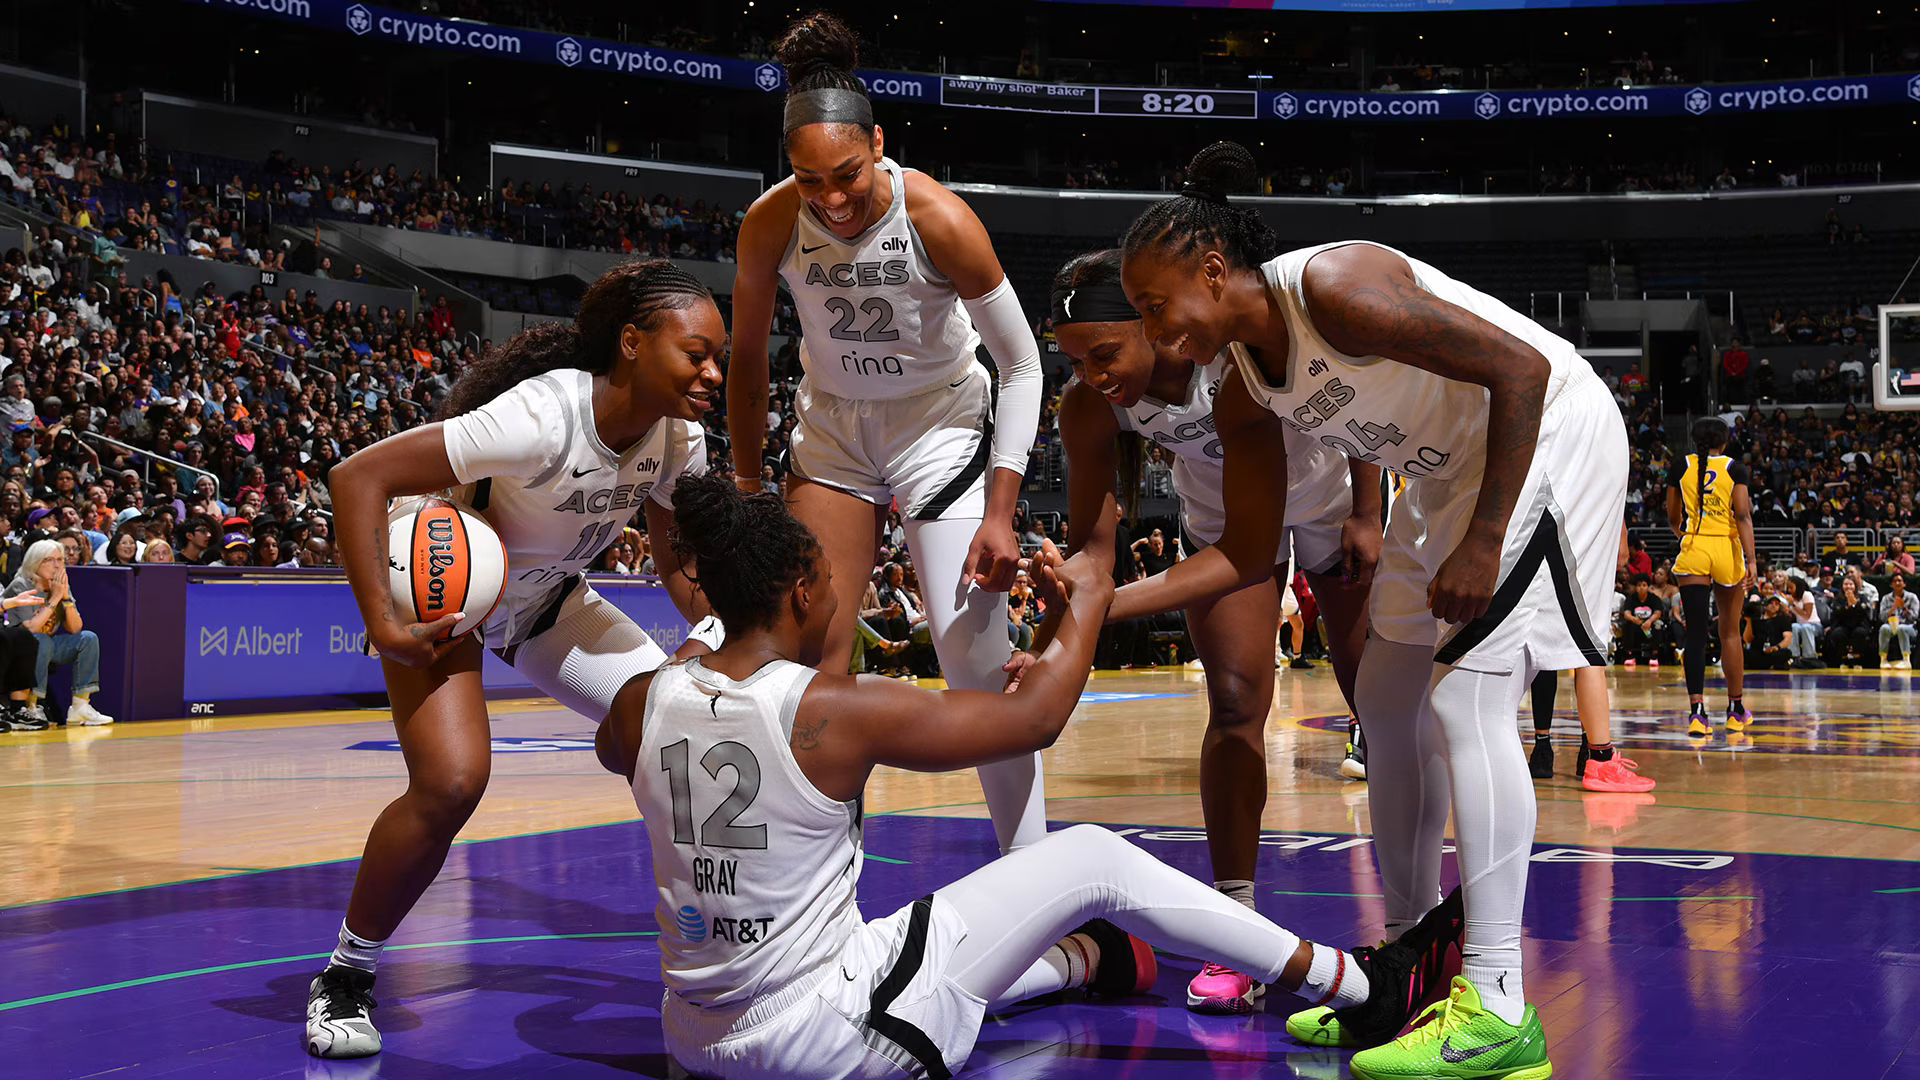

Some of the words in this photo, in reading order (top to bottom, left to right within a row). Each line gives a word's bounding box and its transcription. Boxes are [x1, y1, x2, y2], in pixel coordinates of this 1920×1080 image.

[379, 16, 521, 53] crypto.com
[589, 46, 722, 80] crypto.com
[949, 79, 982, 91] away
[986, 82, 1005, 93] my
[1047, 86, 1086, 96] Baker
[1719, 84, 1869, 110] crypto.com
[1142, 93, 1215, 114] 8:20
[1305, 97, 1440, 118] crypto.com
[1507, 91, 1648, 116] crypto.com
[881, 237, 908, 253] ally
[261, 272, 275, 285] 103
[805, 260, 910, 287] ACES
[824, 297, 900, 342] 22
[1048, 343, 1059, 352] 105
[841, 350, 904, 376] ring
[1308, 357, 1330, 377] ally
[1280, 377, 1356, 432] ACES
[1152, 411, 1217, 443] ACE
[1320, 418, 1408, 463] 24
[636, 457, 661, 475] ally
[1702, 470, 1718, 494] 2
[553, 481, 656, 514] ACES
[562, 519, 616, 562] 11
[427, 516, 454, 611] Wilson
[233, 626, 303, 655] Albert
[191, 703, 214, 713] anc
[661, 738, 768, 850] 12
[693, 856, 738, 896] GRAY
[712, 917, 775, 944] AT&T
